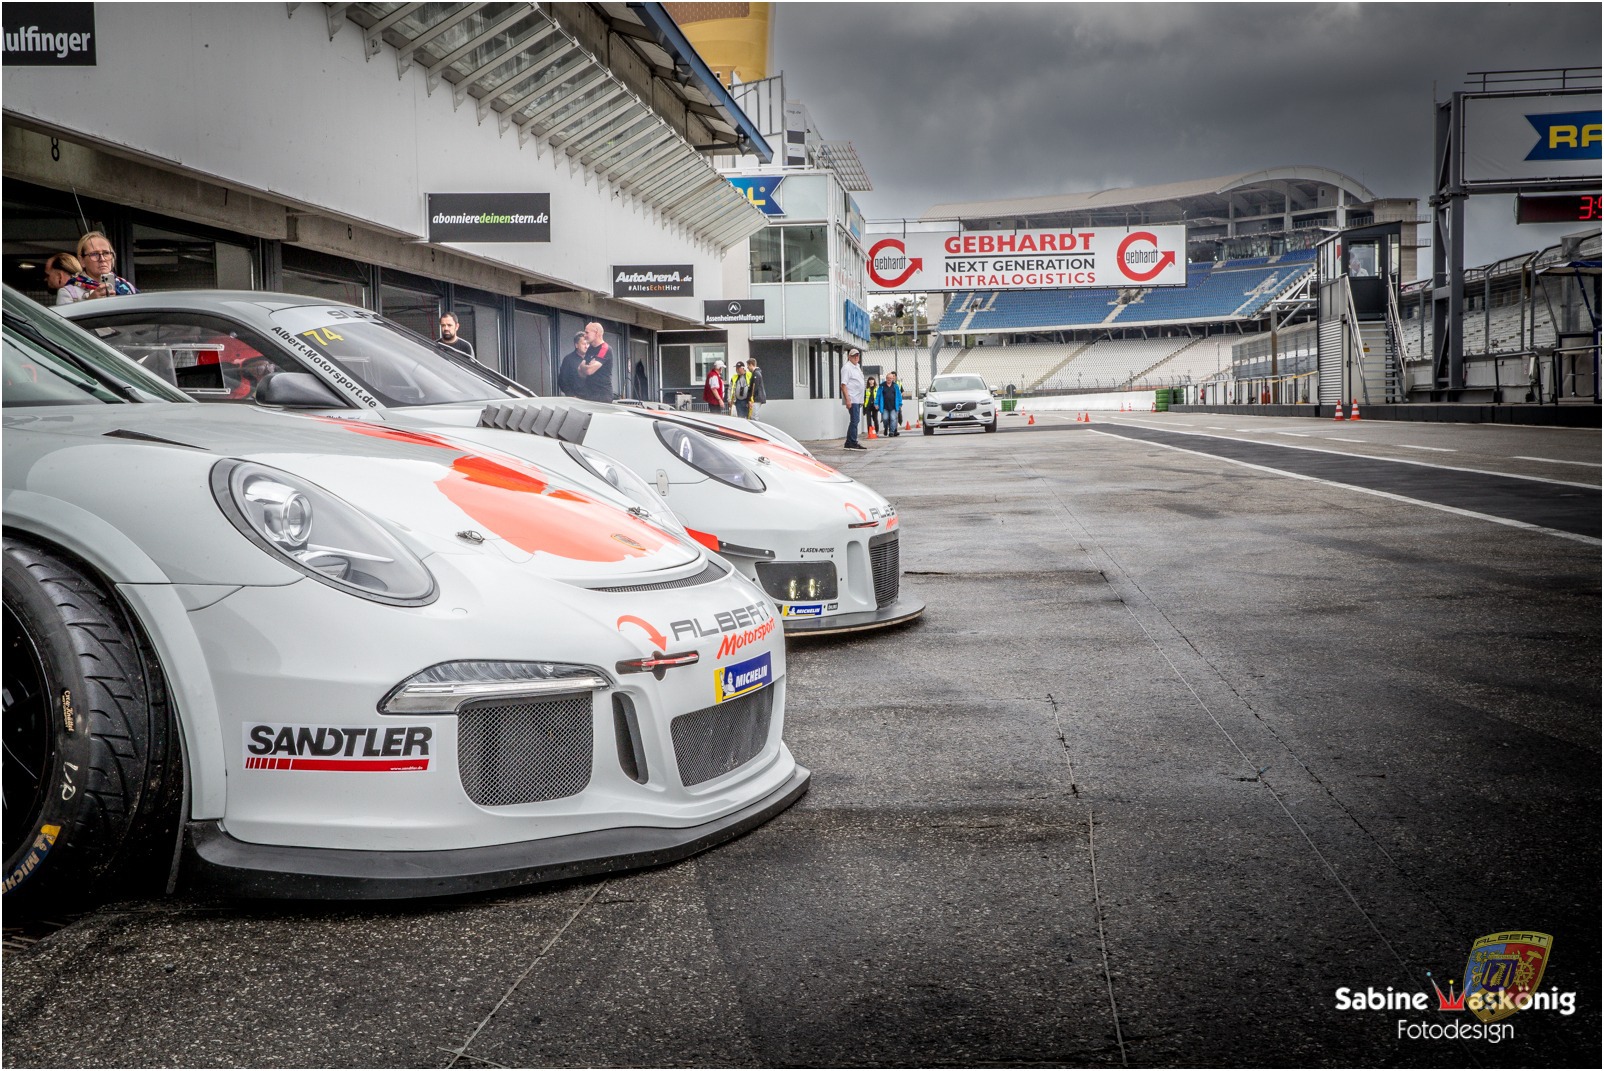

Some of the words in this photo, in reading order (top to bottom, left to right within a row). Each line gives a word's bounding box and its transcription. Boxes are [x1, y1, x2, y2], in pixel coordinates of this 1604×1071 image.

[51, 136, 60, 161] 8
[432, 212, 549, 224] abonnieredeinenstern.de
[944, 232, 1096, 254] GEBHARDT
[874, 255, 907, 270] gebhardt
[945, 260, 988, 273] NEXT
[993, 258, 1096, 272] GENERATION
[1125, 248, 1158, 264] gebhardt
[628, 284, 681, 292] #AllesEchtHier
[944, 272, 1096, 287] INTRALOGISTICS
[303, 322, 345, 346] 74
[271, 326, 377, 408] Albert-Motorsport.de
[670, 600, 770, 641] ALBERT
[716, 616, 776, 660] Motorsport
[735, 664, 768, 688] MICHELIN
[247, 725, 433, 757] SANDTLER
